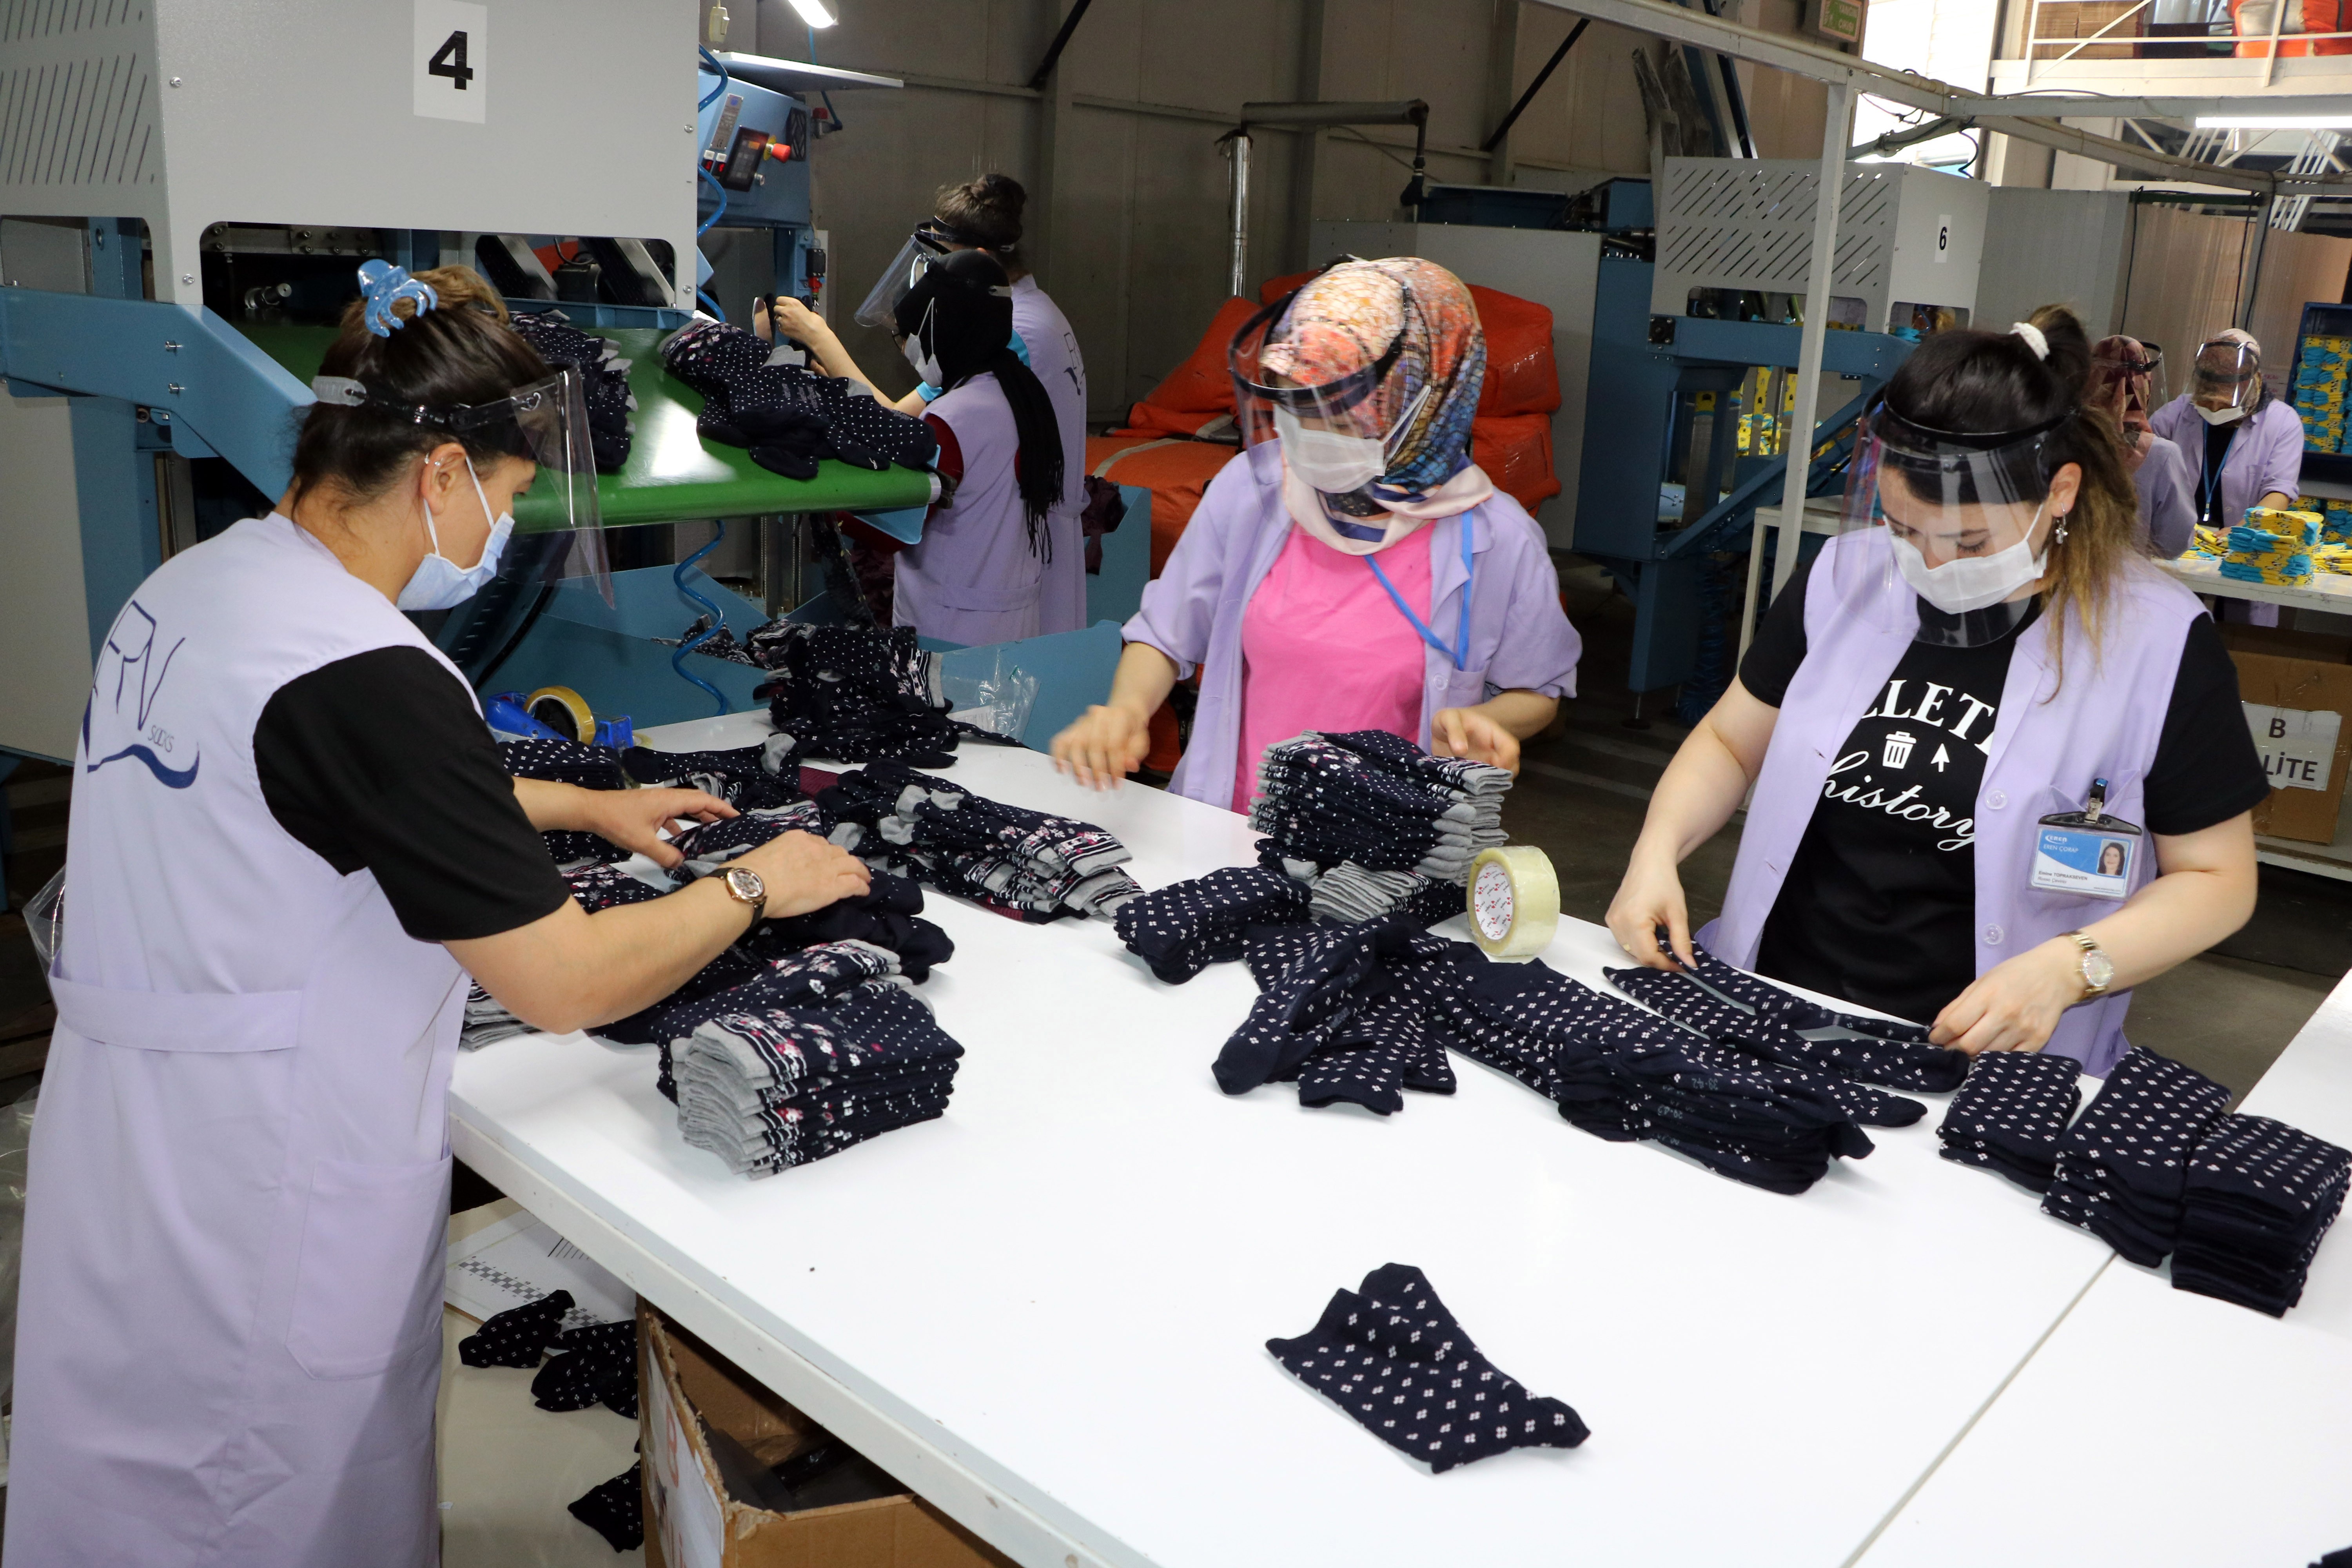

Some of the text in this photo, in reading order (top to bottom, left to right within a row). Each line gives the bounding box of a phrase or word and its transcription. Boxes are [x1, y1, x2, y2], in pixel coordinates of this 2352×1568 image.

[428, 31, 474, 91] 4
[1939, 226, 1948, 250] 6
[147, 724, 175, 753] SOCKS
[1862, 679, 1996, 756] LET
[2269, 718, 2286, 739] B
[1824, 750, 1975, 851] history
